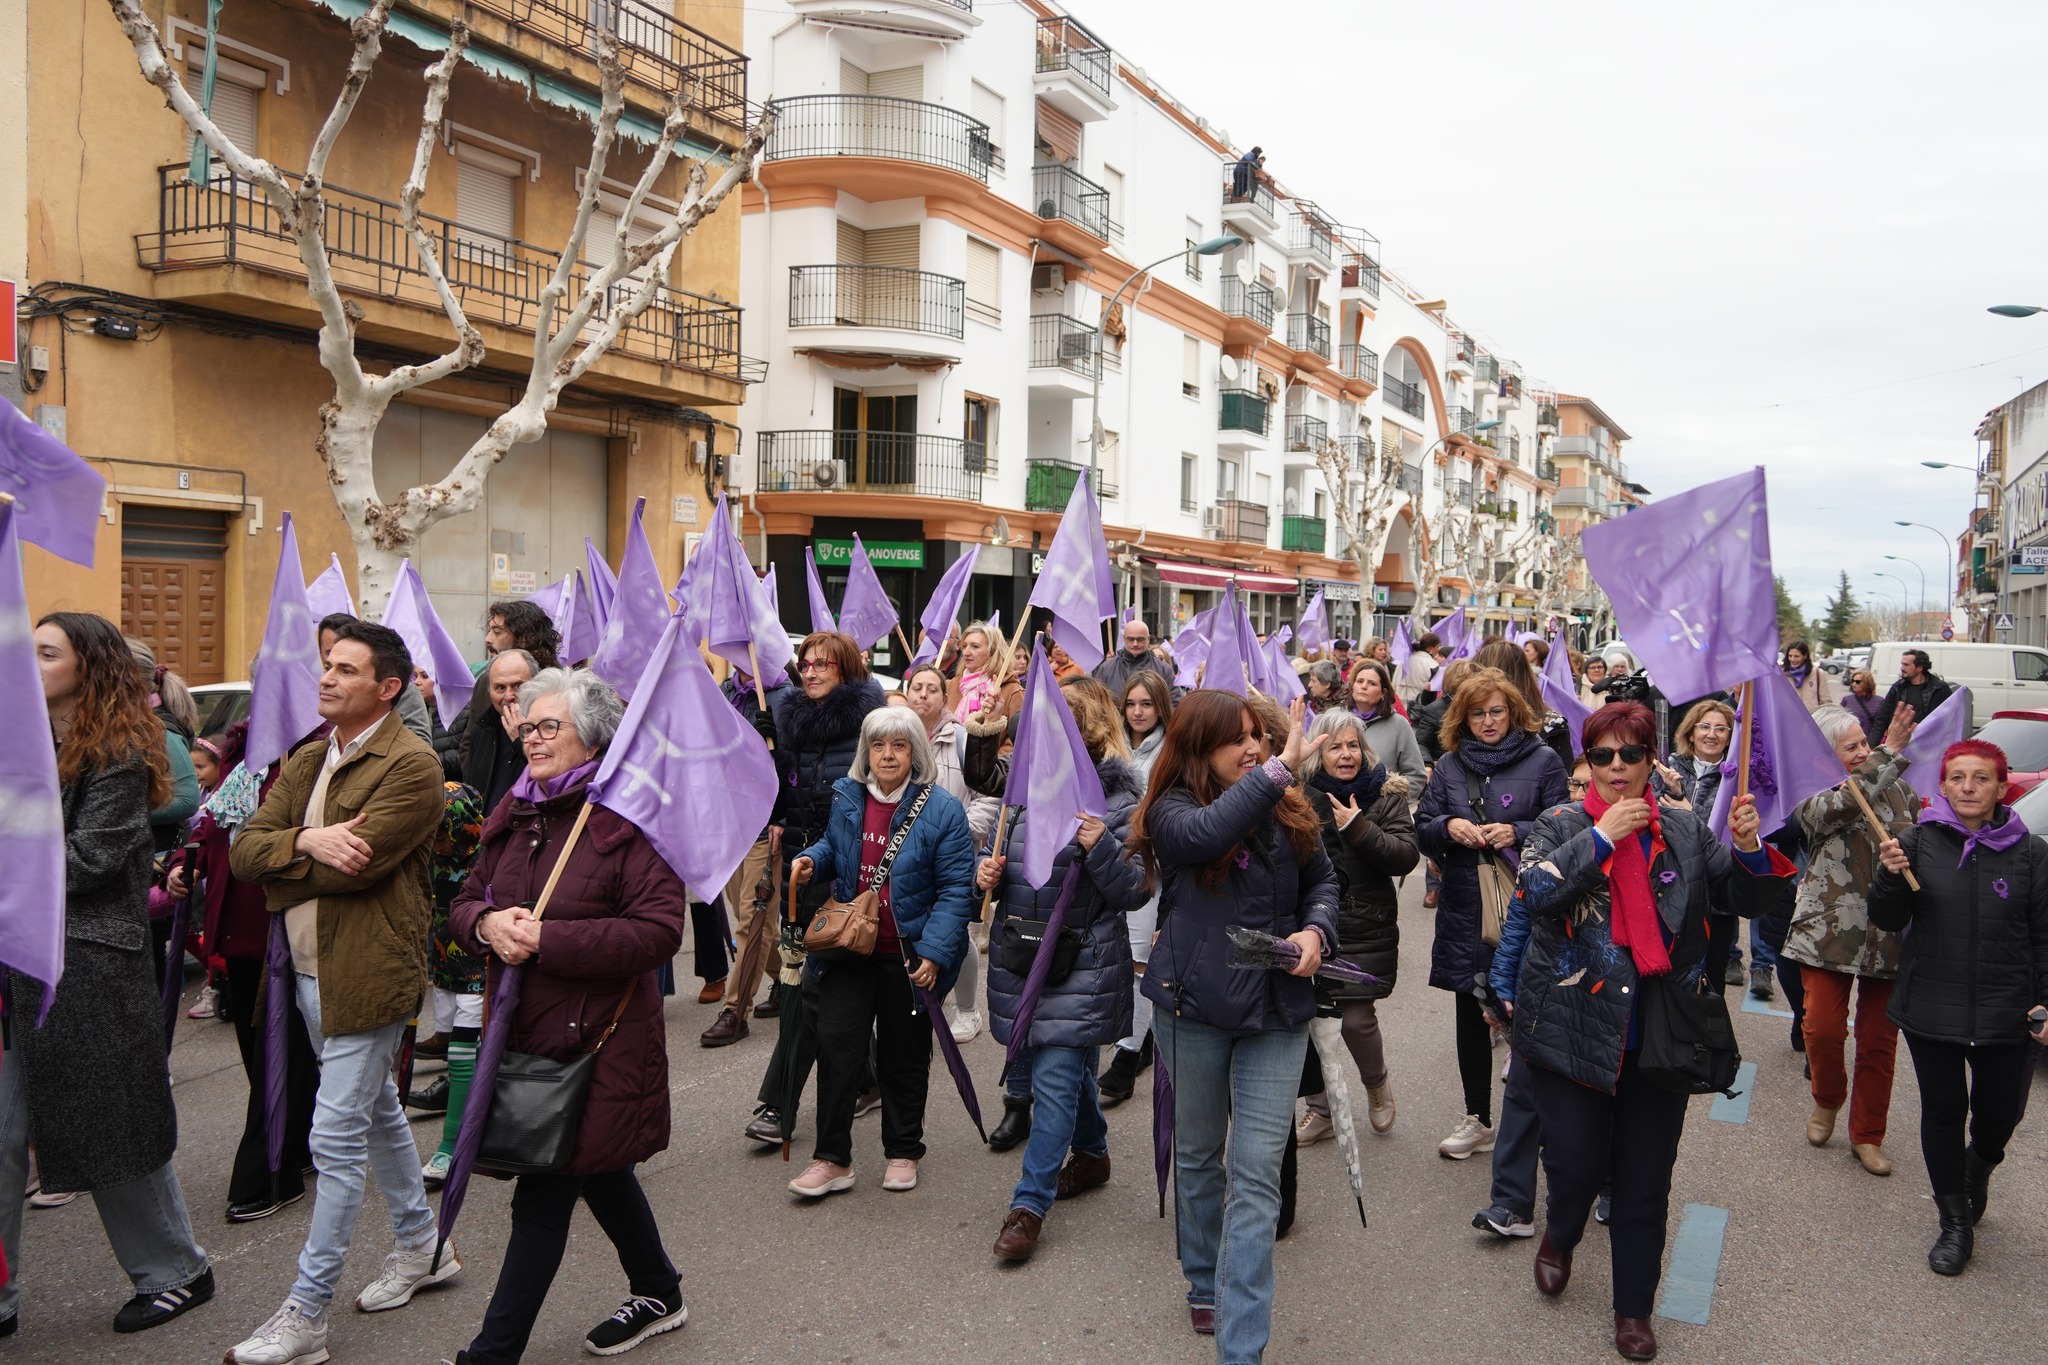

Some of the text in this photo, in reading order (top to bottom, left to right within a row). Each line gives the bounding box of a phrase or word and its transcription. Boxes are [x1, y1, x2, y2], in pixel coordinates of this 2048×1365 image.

[833, 547, 920, 560] CF VANOVENSE
[885, 820, 909, 860] JAGAS
